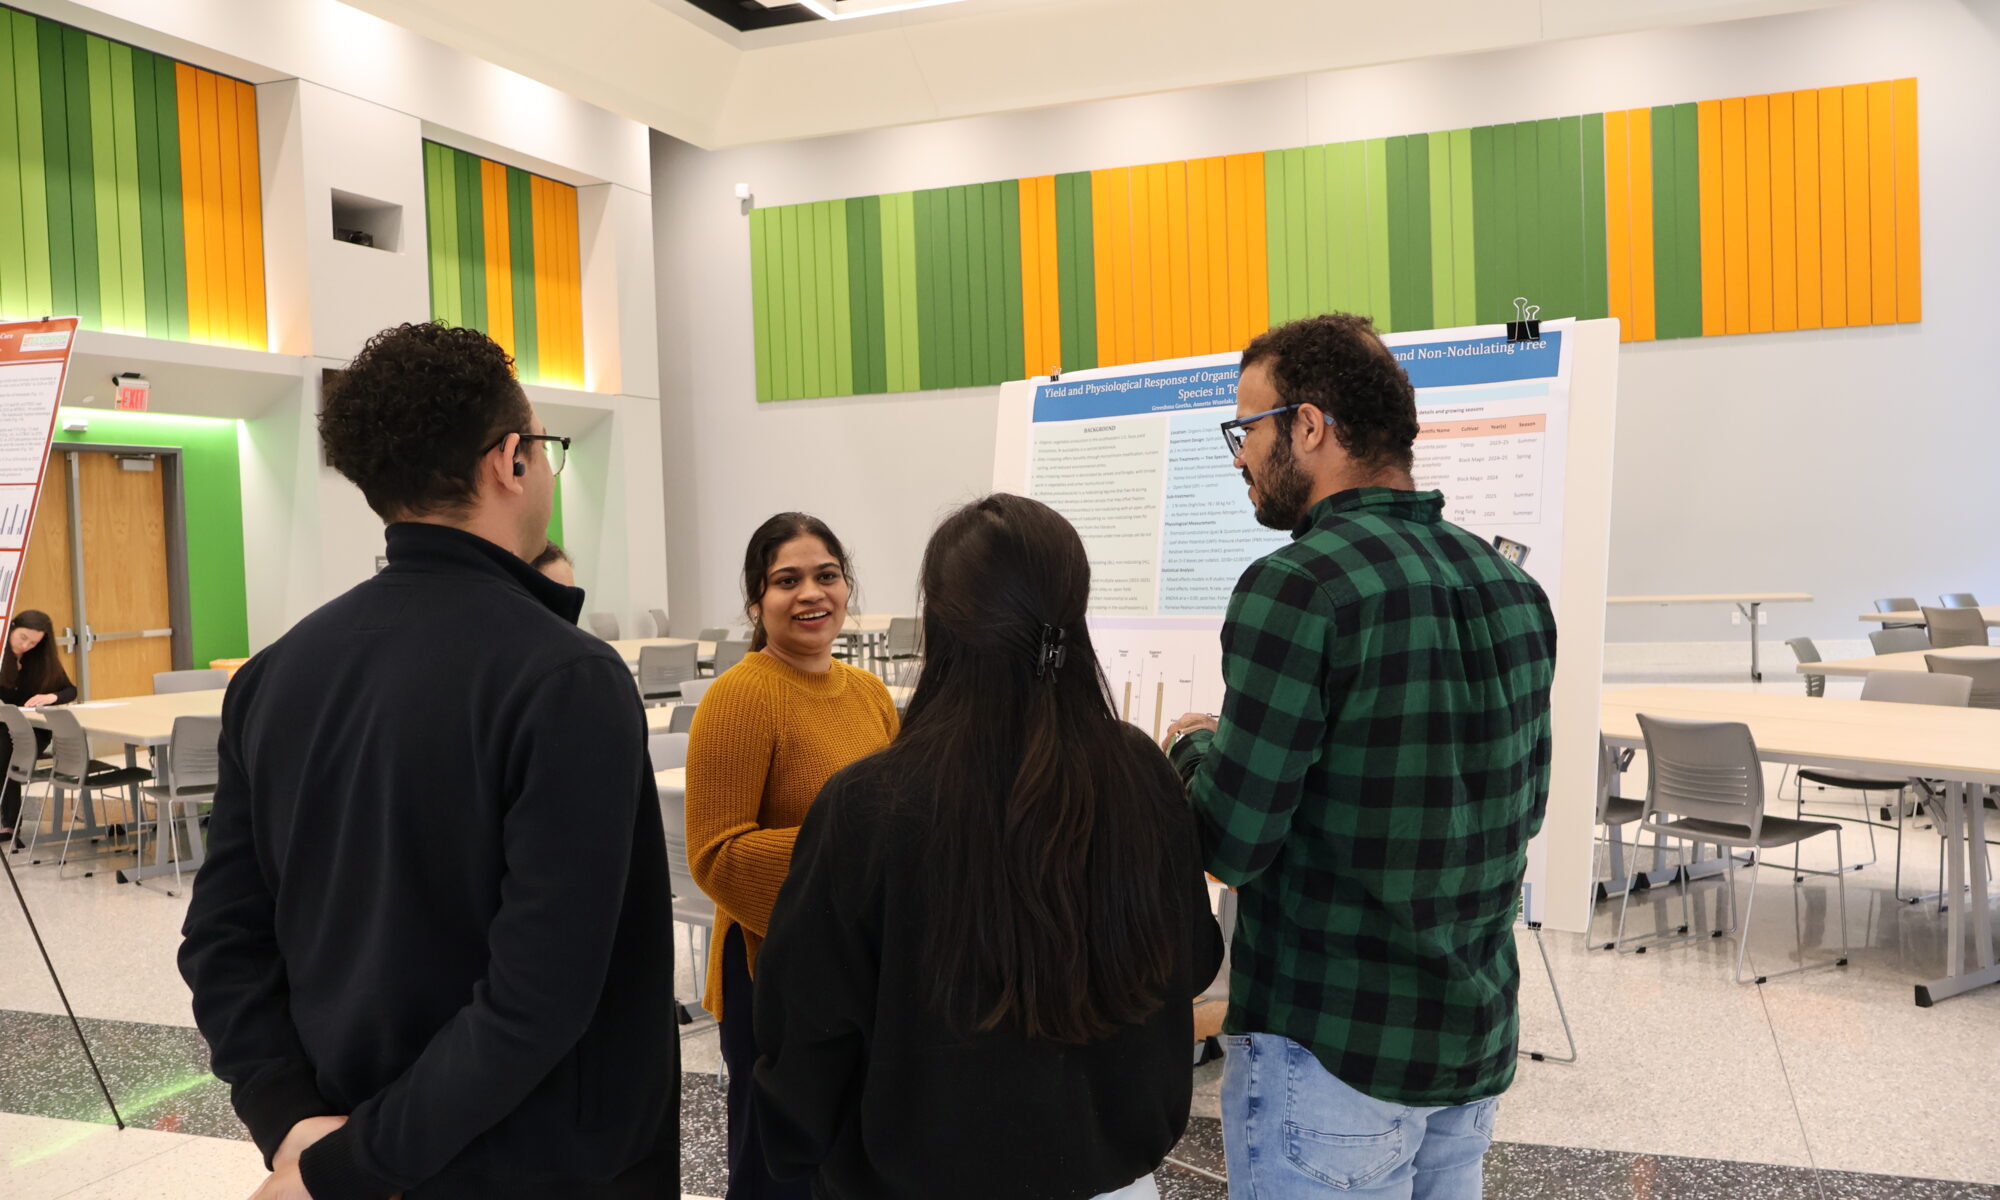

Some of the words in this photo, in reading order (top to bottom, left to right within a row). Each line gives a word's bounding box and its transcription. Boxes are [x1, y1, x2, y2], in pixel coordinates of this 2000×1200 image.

[1394, 349, 1414, 362] and
[1418, 343, 1514, 359] Non-Nodulating
[1519, 340, 1547, 350] Tree
[1044, 388, 1067, 398] Yield
[1068, 385, 1084, 396] and
[1086, 378, 1142, 395] Physiological
[1144, 374, 1187, 389] Response
[1189, 372, 1200, 383] of
[1201, 369, 1238, 383] Organic
[1178, 386, 1213, 400] Species
[1216, 385, 1225, 394] in
[122, 387, 146, 409] EXIT
[1084, 425, 1116, 433] BACKGROUND
